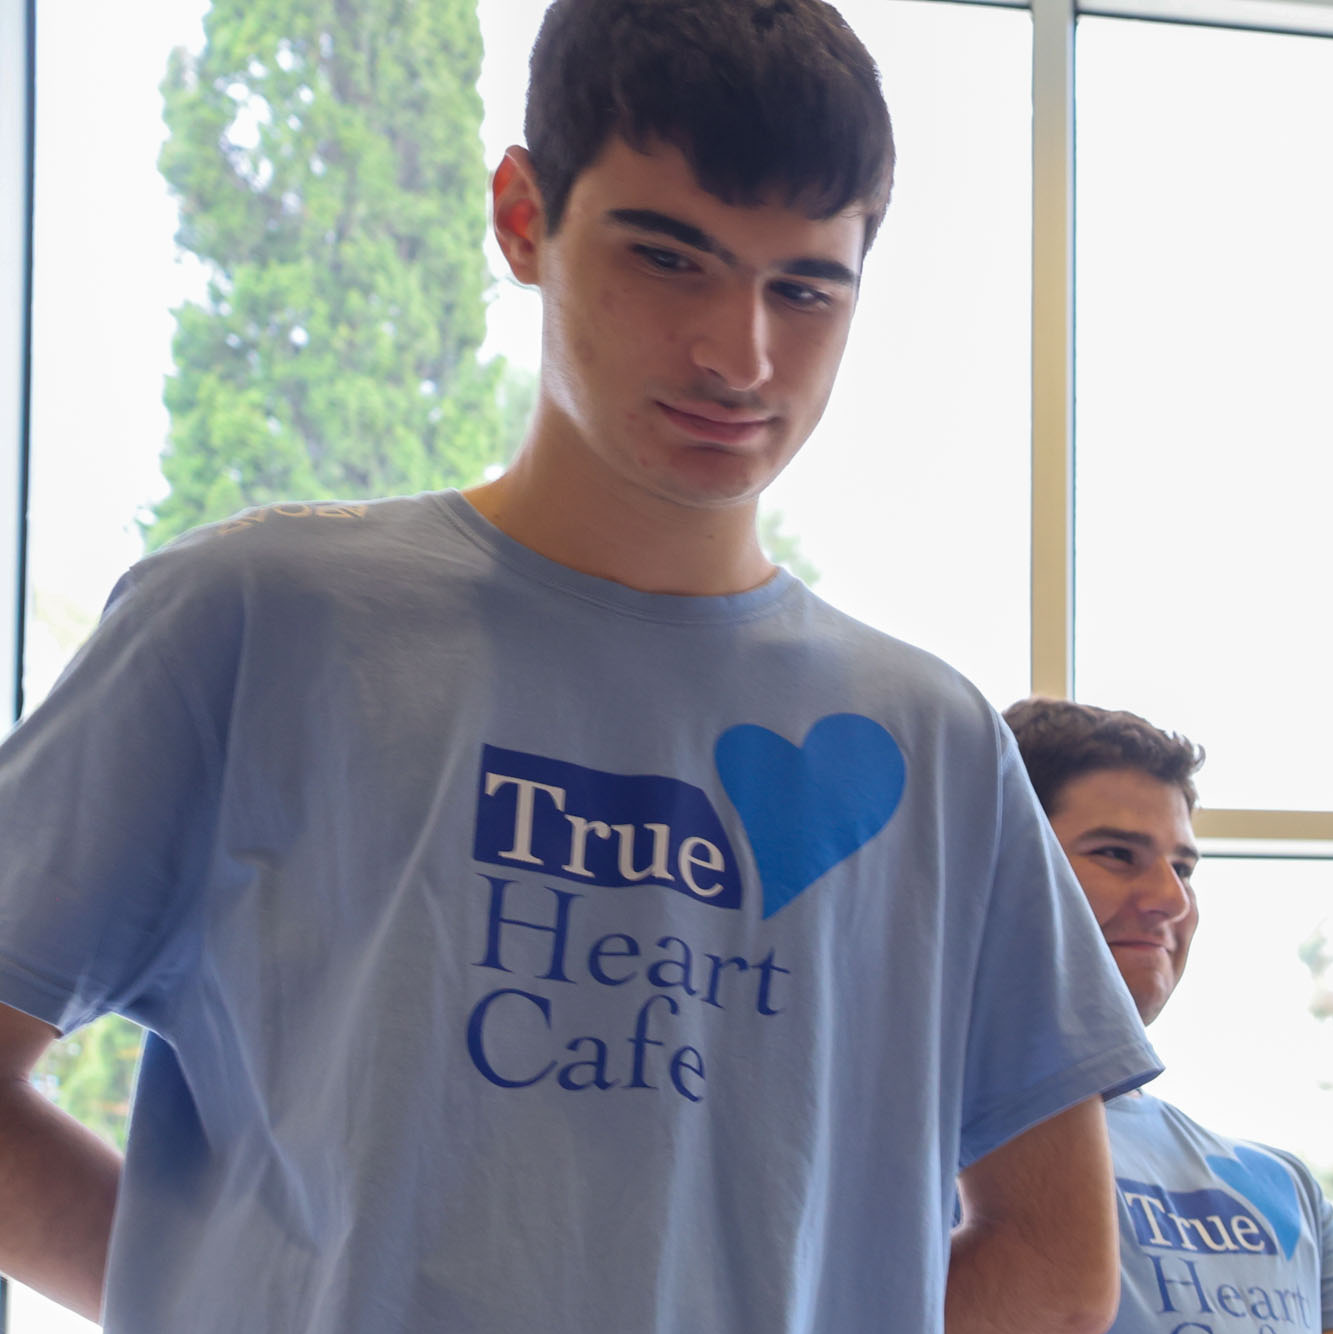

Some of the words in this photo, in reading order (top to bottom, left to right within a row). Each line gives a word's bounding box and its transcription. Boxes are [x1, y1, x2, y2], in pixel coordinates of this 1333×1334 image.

[485, 772, 725, 897] True
[472, 873, 791, 1016] Heart
[467, 988, 706, 1103] Cafe
[1124, 1192, 1265, 1252] True
[1147, 1254, 1311, 1330] Heart
